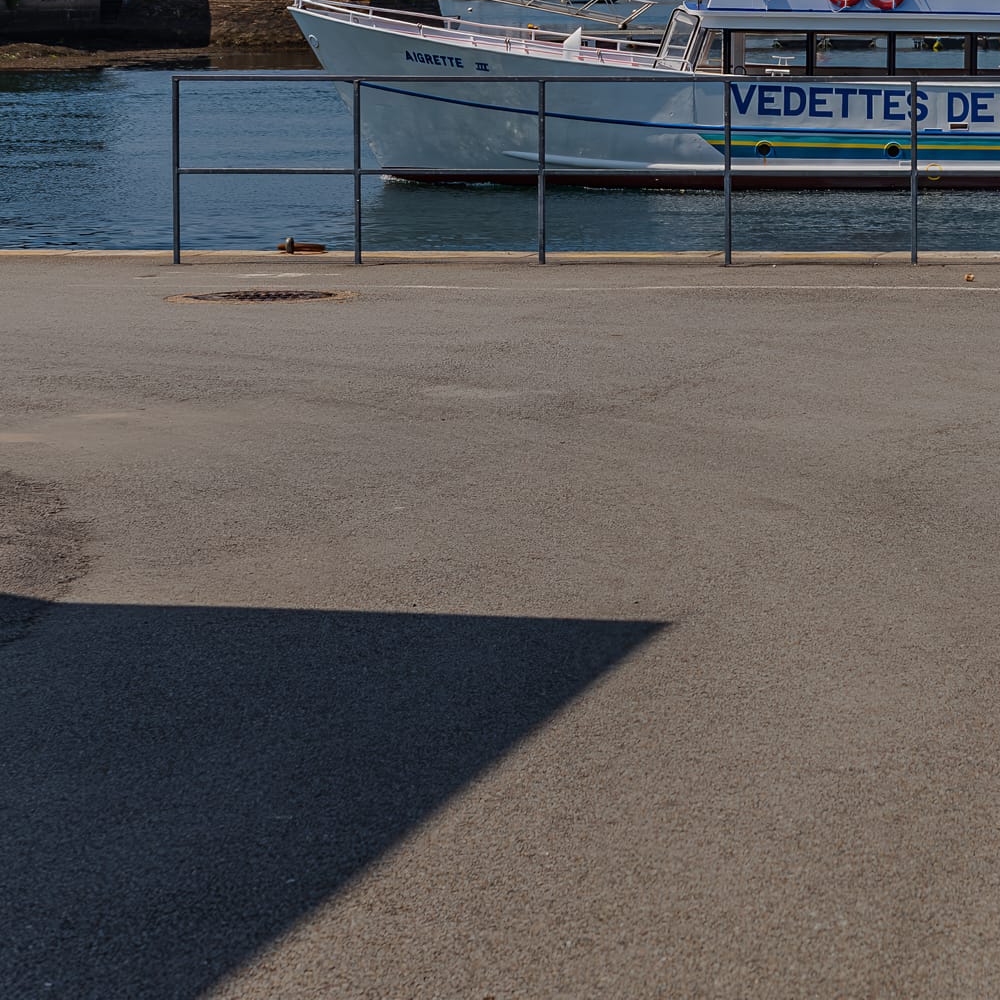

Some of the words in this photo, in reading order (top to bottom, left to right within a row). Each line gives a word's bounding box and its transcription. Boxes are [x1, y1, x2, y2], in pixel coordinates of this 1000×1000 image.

[405, 50, 464, 68] AIGRETTE
[475, 62, 490, 72] III
[730, 84, 929, 122] VEDETTES
[947, 92, 995, 123] DE
